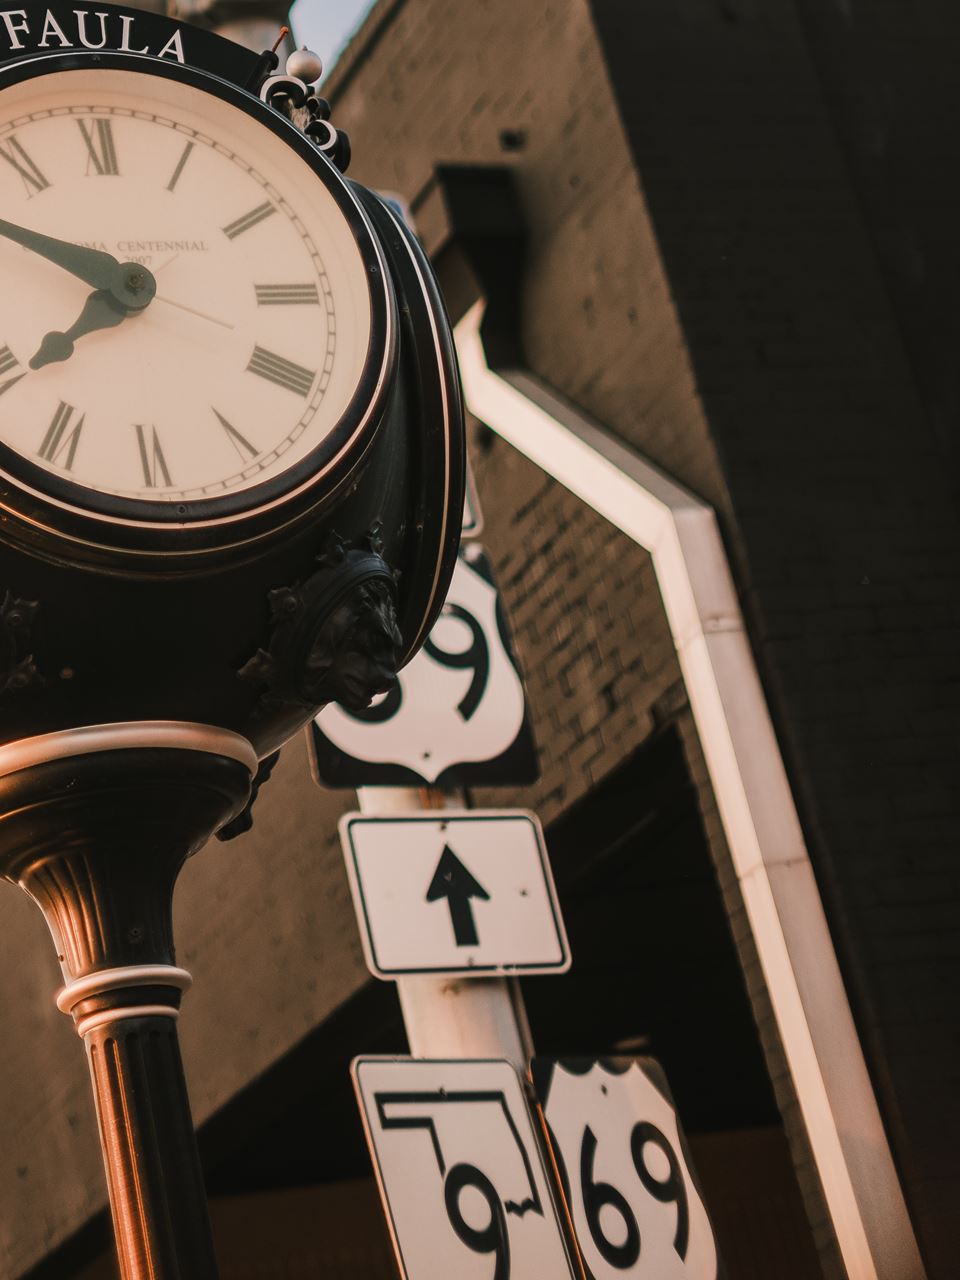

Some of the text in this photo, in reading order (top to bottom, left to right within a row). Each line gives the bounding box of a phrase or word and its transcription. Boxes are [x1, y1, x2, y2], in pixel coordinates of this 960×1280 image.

[74, 118, 122, 176] XII
[165, 140, 195, 193] I
[117, 240, 208, 251] CENTENNIAL
[221, 200, 278, 240] II
[253, 283, 321, 307] III
[444, 1162, 510, 1280] 9
[580, 1120, 690, 1270] 69
